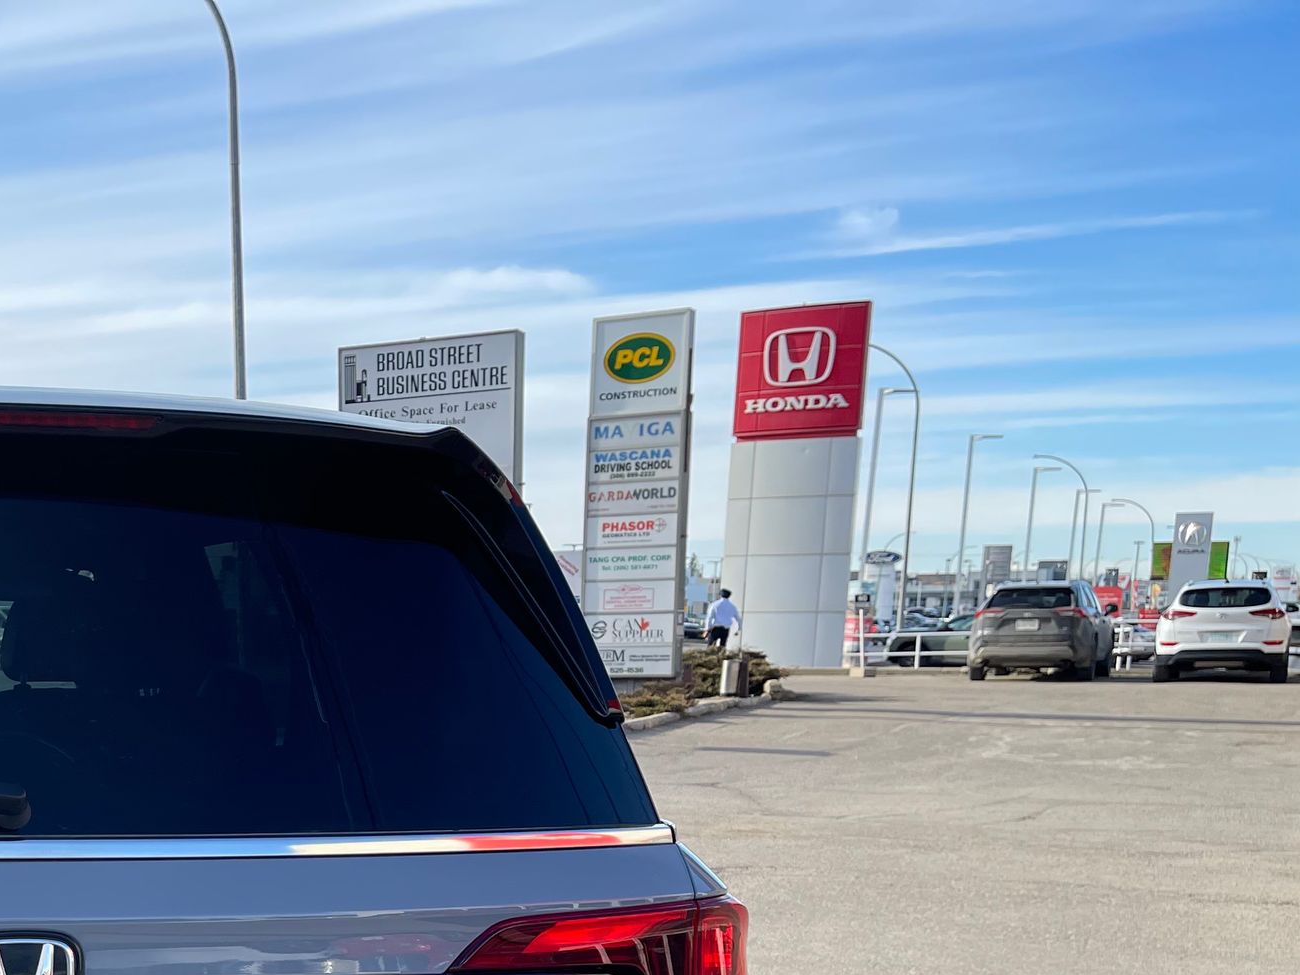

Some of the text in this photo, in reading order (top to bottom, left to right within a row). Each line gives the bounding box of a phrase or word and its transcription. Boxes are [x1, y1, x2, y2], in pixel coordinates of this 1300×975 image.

[377, 343, 483, 372] BROAD STREET
[614, 345, 665, 371] PCL
[376, 365, 508, 396] BUSINESS CENTRE
[599, 387, 678, 401] CONSTRUCTION
[358, 400, 498, 419] Office Space For Lease
[744, 393, 850, 414] HONDA
[595, 448, 673, 463] WASCANA
[594, 459, 673, 474] DRIVING SCHOOL
[602, 520, 654, 532] PHASOR
[589, 556, 610, 564] TANG
[612, 618, 643, 632] CAN
[611, 628, 665, 639] SUPPLIER
